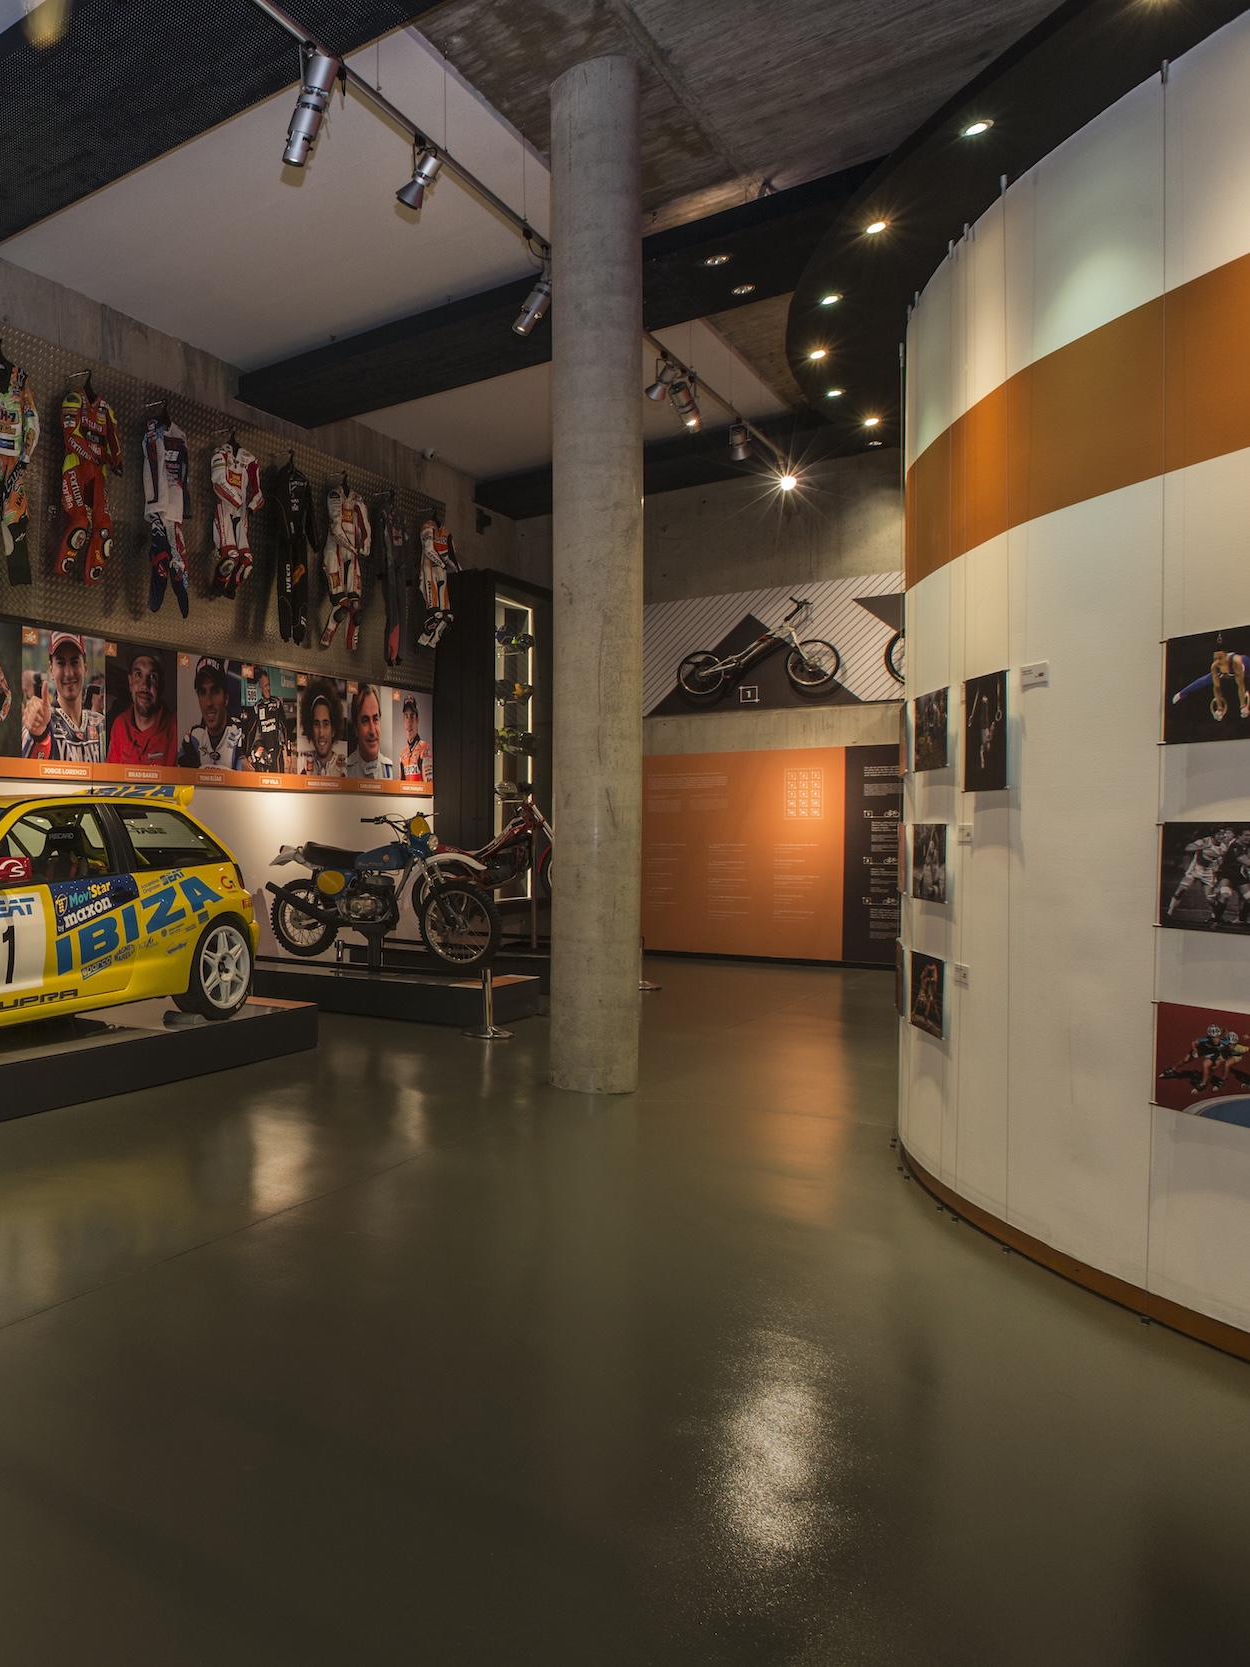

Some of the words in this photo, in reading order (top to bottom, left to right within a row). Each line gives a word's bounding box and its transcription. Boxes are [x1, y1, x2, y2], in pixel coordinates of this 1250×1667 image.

[68, 436, 91, 461] Fortuna
[68, 470, 83, 507] Fortuna
[746, 690, 751, 698] 1
[43, 767, 62, 775] JORGE
[62, 768, 87, 776] LORENZO
[86, 785, 175, 797] IBIZA
[49, 832, 74, 840] RECARO
[160, 868, 184, 886] SEAT
[68, 881, 111, 908] MoviStar
[57, 923, 64, 932] by
[64, 896, 112, 929] maxon
[55, 875, 224, 977] IBIZA
[2, 925, 15, 984] 1
[82, 956, 112, 975] sparco
